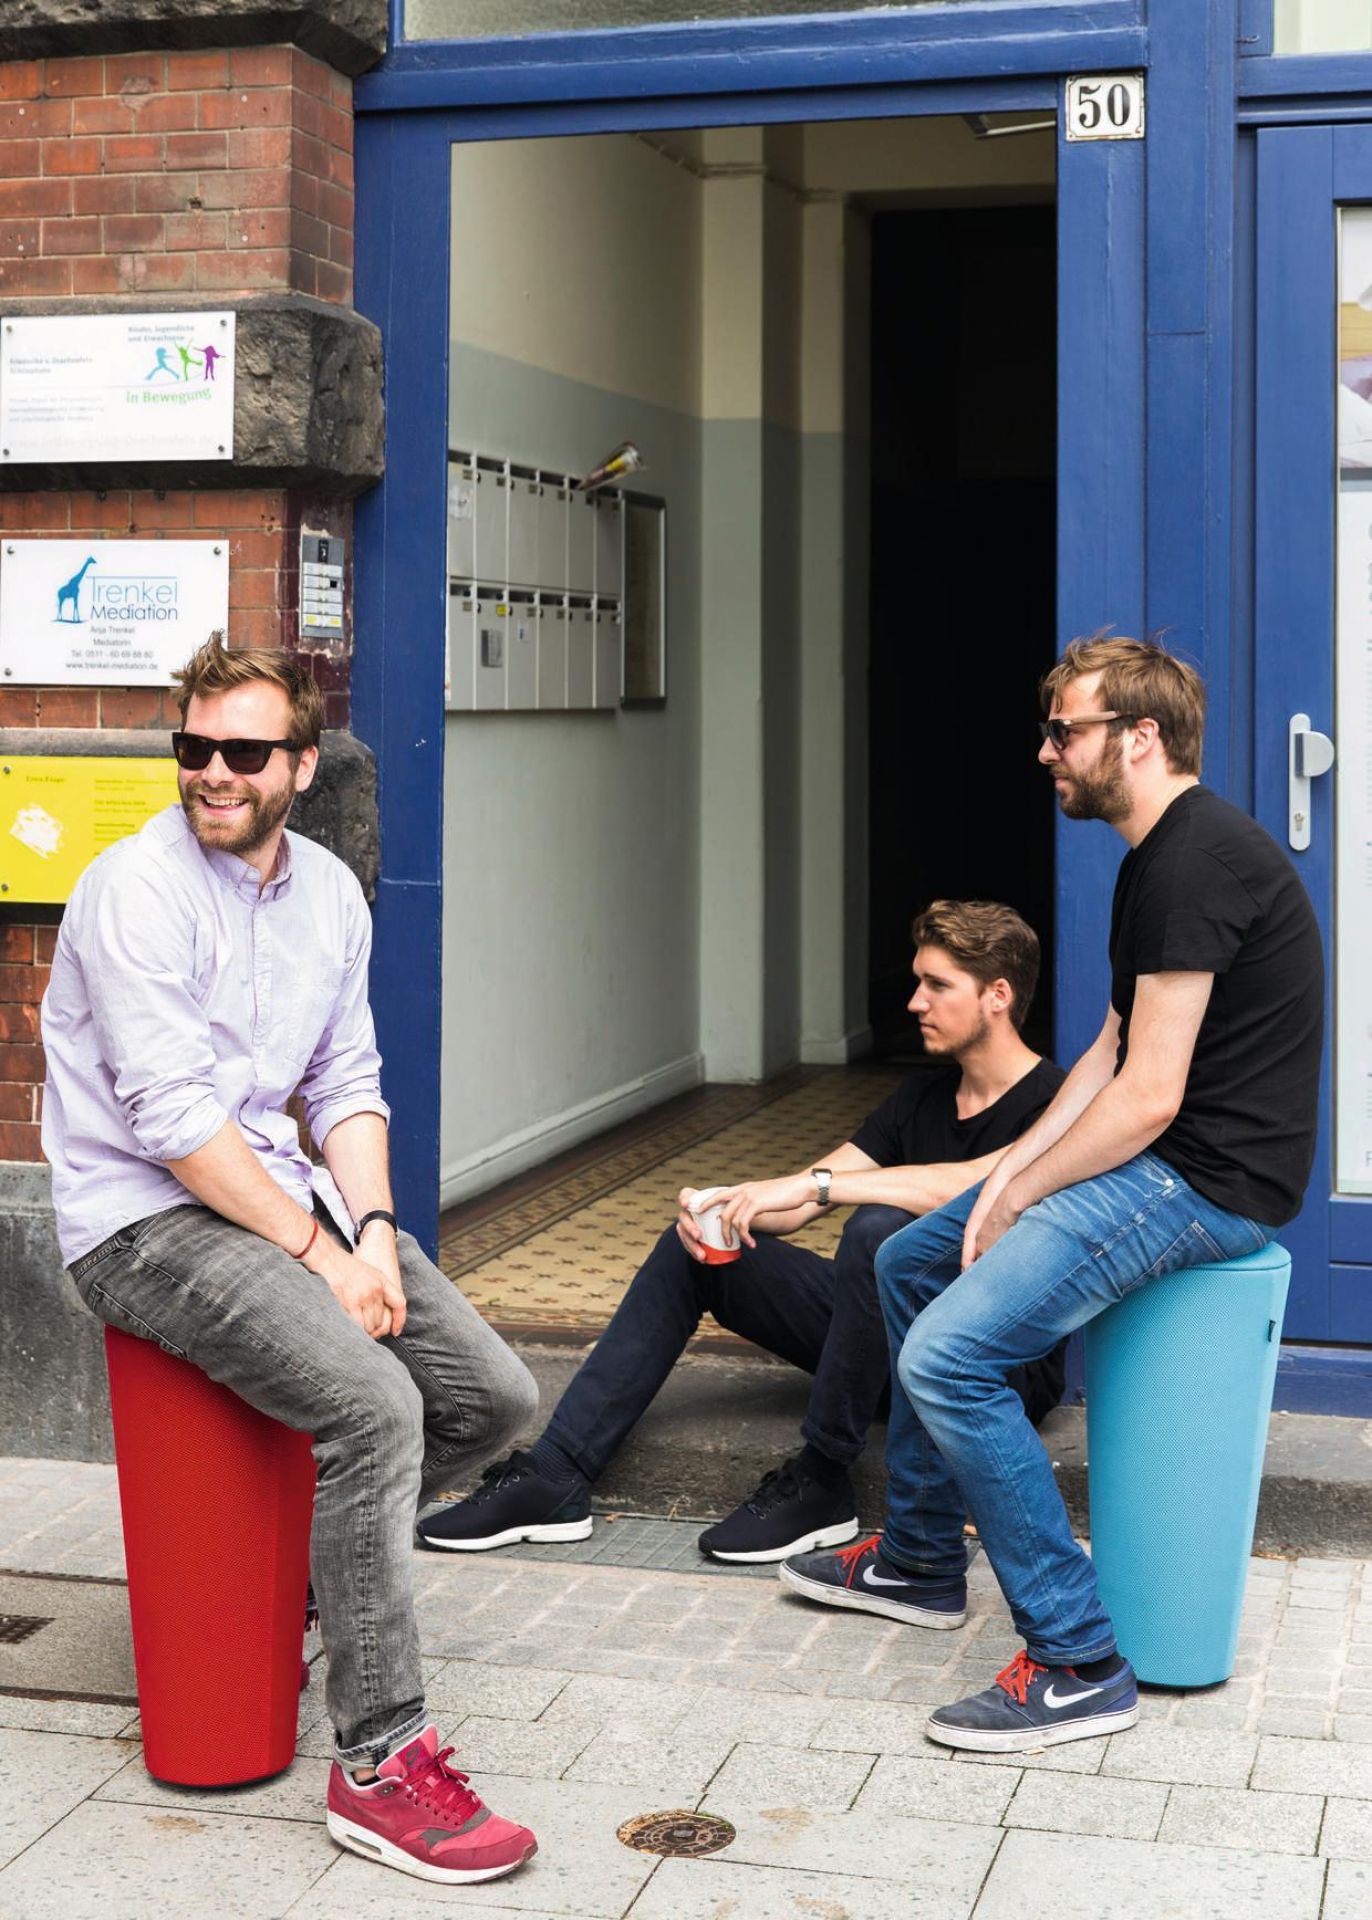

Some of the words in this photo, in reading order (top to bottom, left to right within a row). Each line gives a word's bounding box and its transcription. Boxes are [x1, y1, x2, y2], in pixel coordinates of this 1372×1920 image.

[1079, 83, 1130, 128] 50
[142, 387, 213, 405] Bewegung
[90, 604, 178, 621] Mediation
[109, 626, 135, 634] Trenkel
[93, 638, 131, 646] Mediatorin
